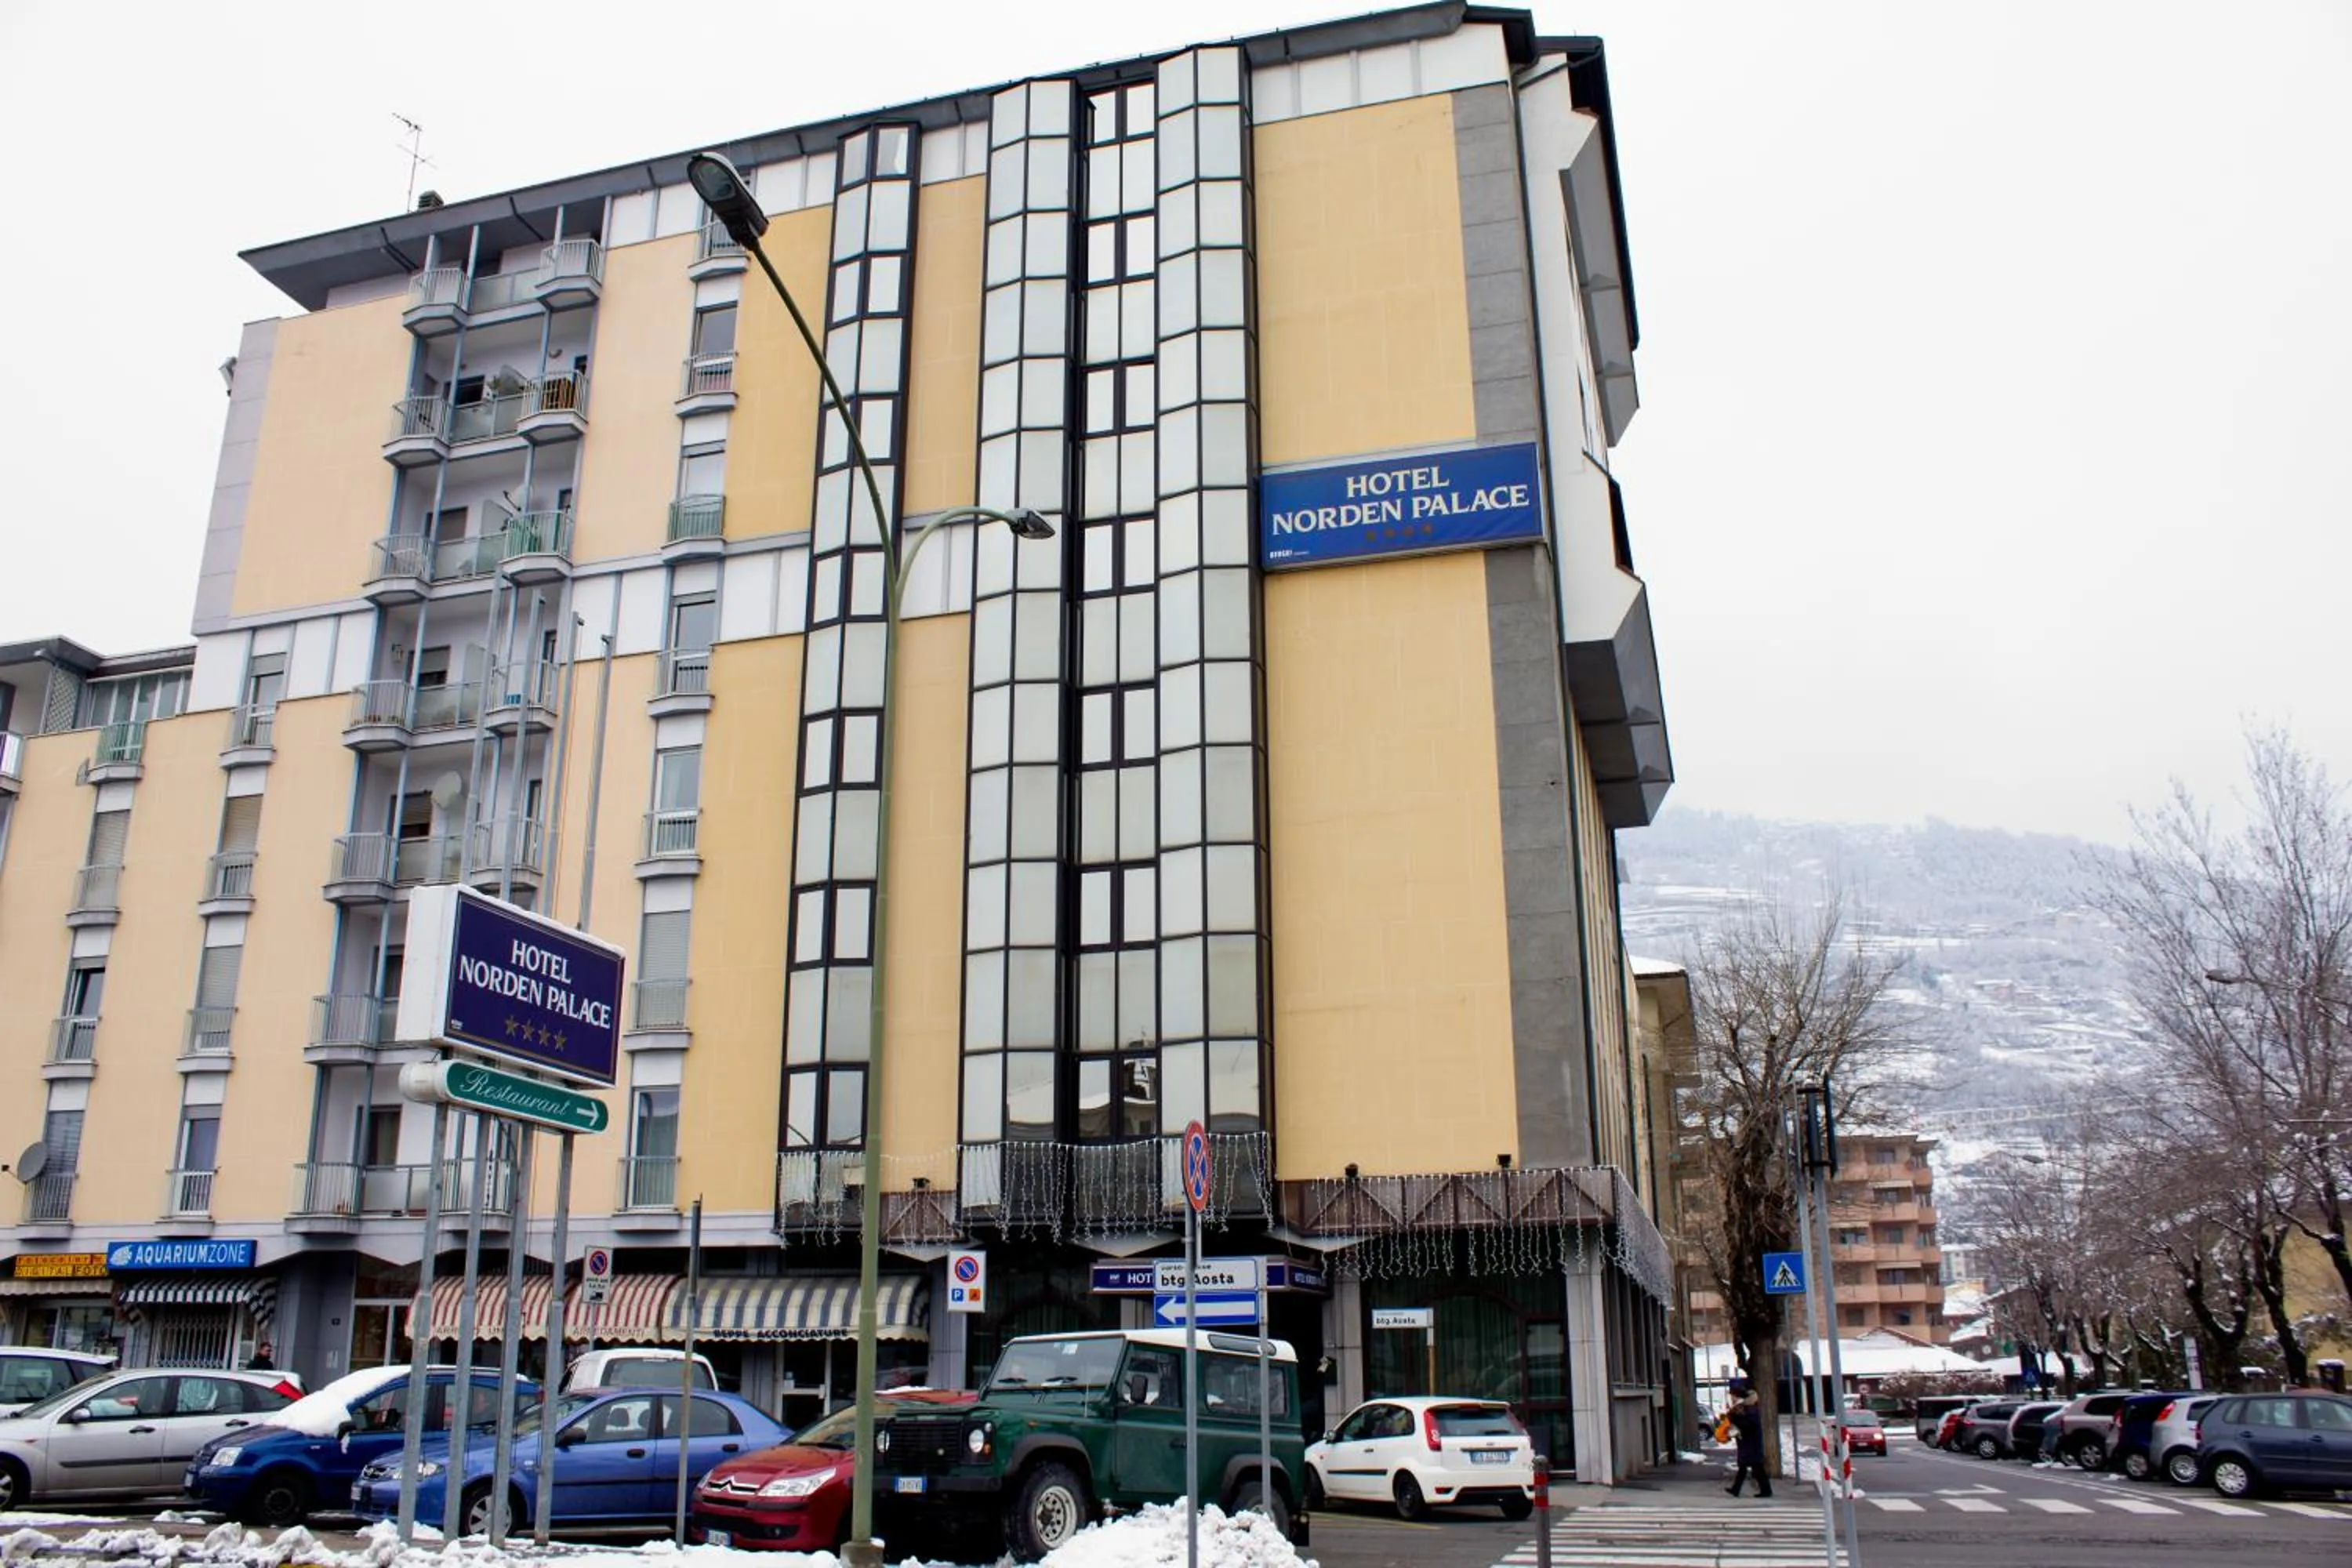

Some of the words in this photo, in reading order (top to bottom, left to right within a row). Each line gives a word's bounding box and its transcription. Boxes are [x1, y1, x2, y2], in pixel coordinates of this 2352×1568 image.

[1346, 466, 1450, 498] HOTEL
[1272, 499, 1402, 535] NORDEN
[1412, 485, 1530, 519] PALACE
[511, 939, 572, 984] HOTEL
[459, 954, 543, 1006] NORDEN
[546, 985, 611, 1029] PALACE
[459, 1069, 570, 1116] Restaurant
[135, 1243, 245, 1263] AQUARIUMZONE
[1127, 1272, 1154, 1283] HOT
[1161, 1274, 1185, 1287] btg
[1193, 1272, 1234, 1285] Aosta
[573, 1327, 644, 1338] ARDAMENTI
[757, 1328, 848, 1338] ACCONCIATURE
